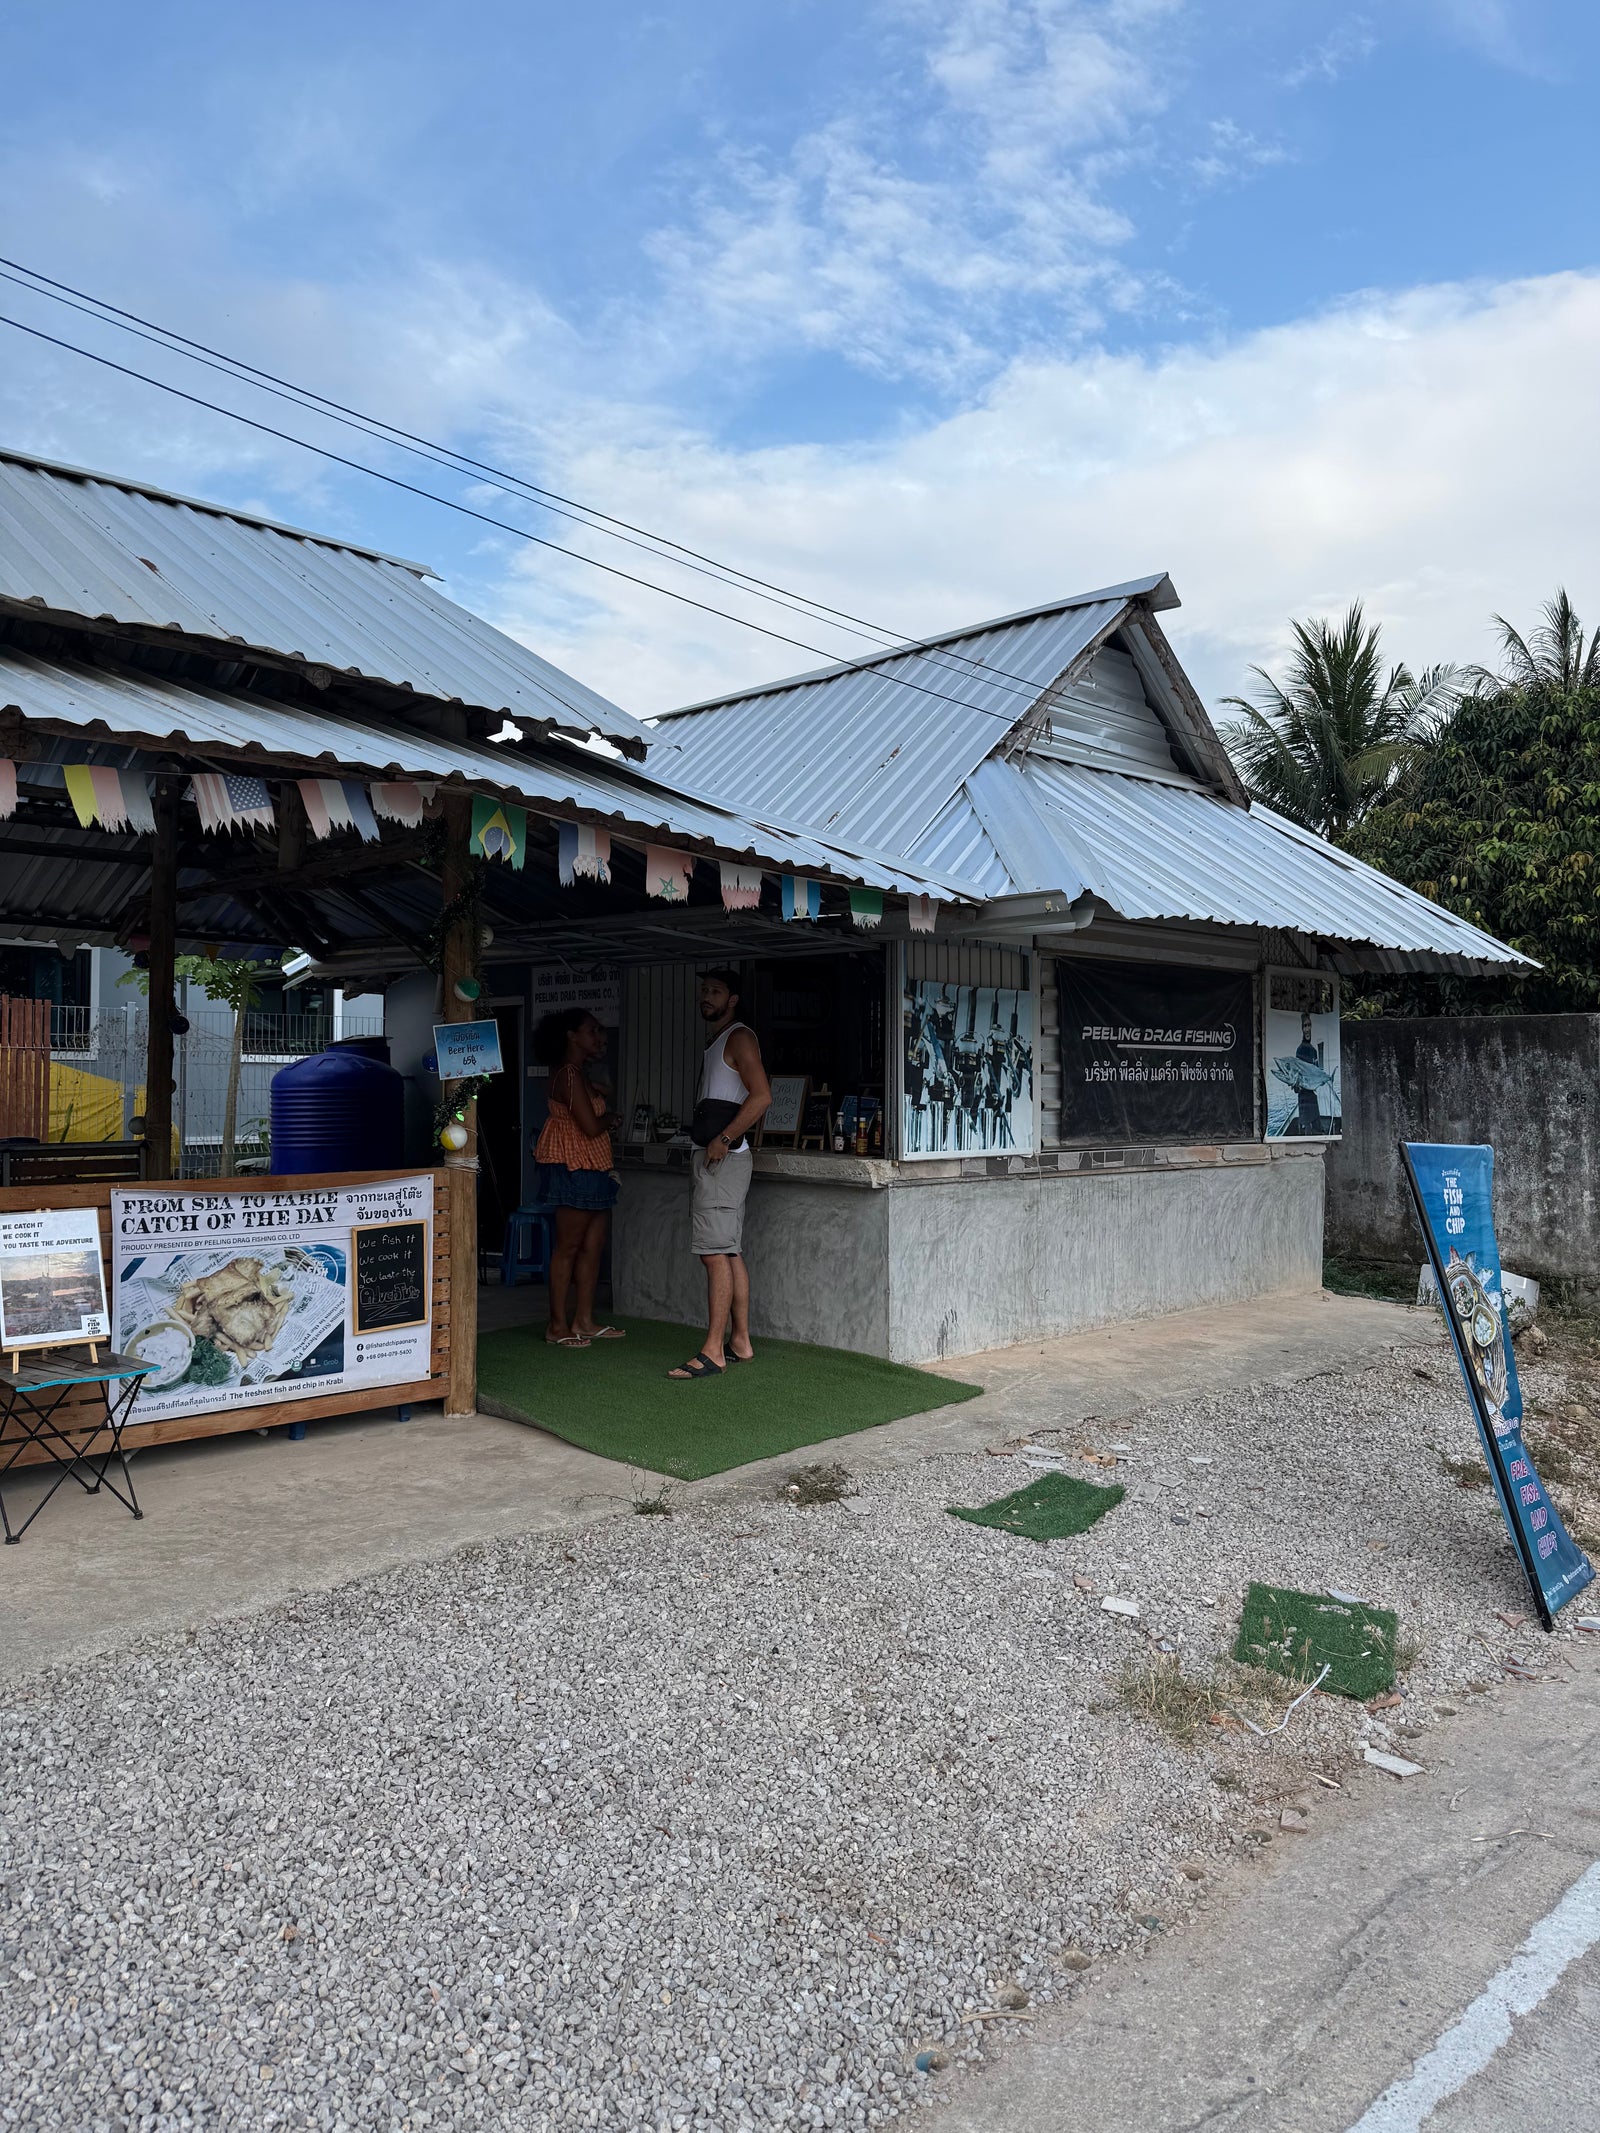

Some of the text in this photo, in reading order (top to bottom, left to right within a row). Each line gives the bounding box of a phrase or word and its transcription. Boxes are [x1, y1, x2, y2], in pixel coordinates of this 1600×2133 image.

[1081, 1025, 1232, 1044] PEELING DRAG FISHING
[447, 1043, 485, 1056] Beer Here
[1084, 1060, 1117, 1082] บริษัท
[1445, 1177, 1458, 1188] THE
[121, 1191, 339, 1215] FROM SEA TO TABLE
[1443, 1188, 1464, 1205] FISH
[14, 1222, 36, 1230] CATCH
[121, 1206, 338, 1235] CATCH OF THE DAY
[1445, 1217, 1466, 1235] CHIP
[56, 1237, 94, 1246] ADVENTURE
[120, 1243, 153, 1251] PROUDLY
[153, 1240, 194, 1249] PRESENTED
[194, 1239, 204, 1247] BY
[204, 1238, 232, 1246] PEELING
[232, 1236, 251, 1244] DRAG
[251, 1234, 277, 1242] FISHING
[378, 1252, 399, 1262] cook
[404, 1249, 413, 1260] it
[229, 1376, 344, 1400] The freshest fish and chip in Krabi
[1530, 1506, 1548, 1533] AND
